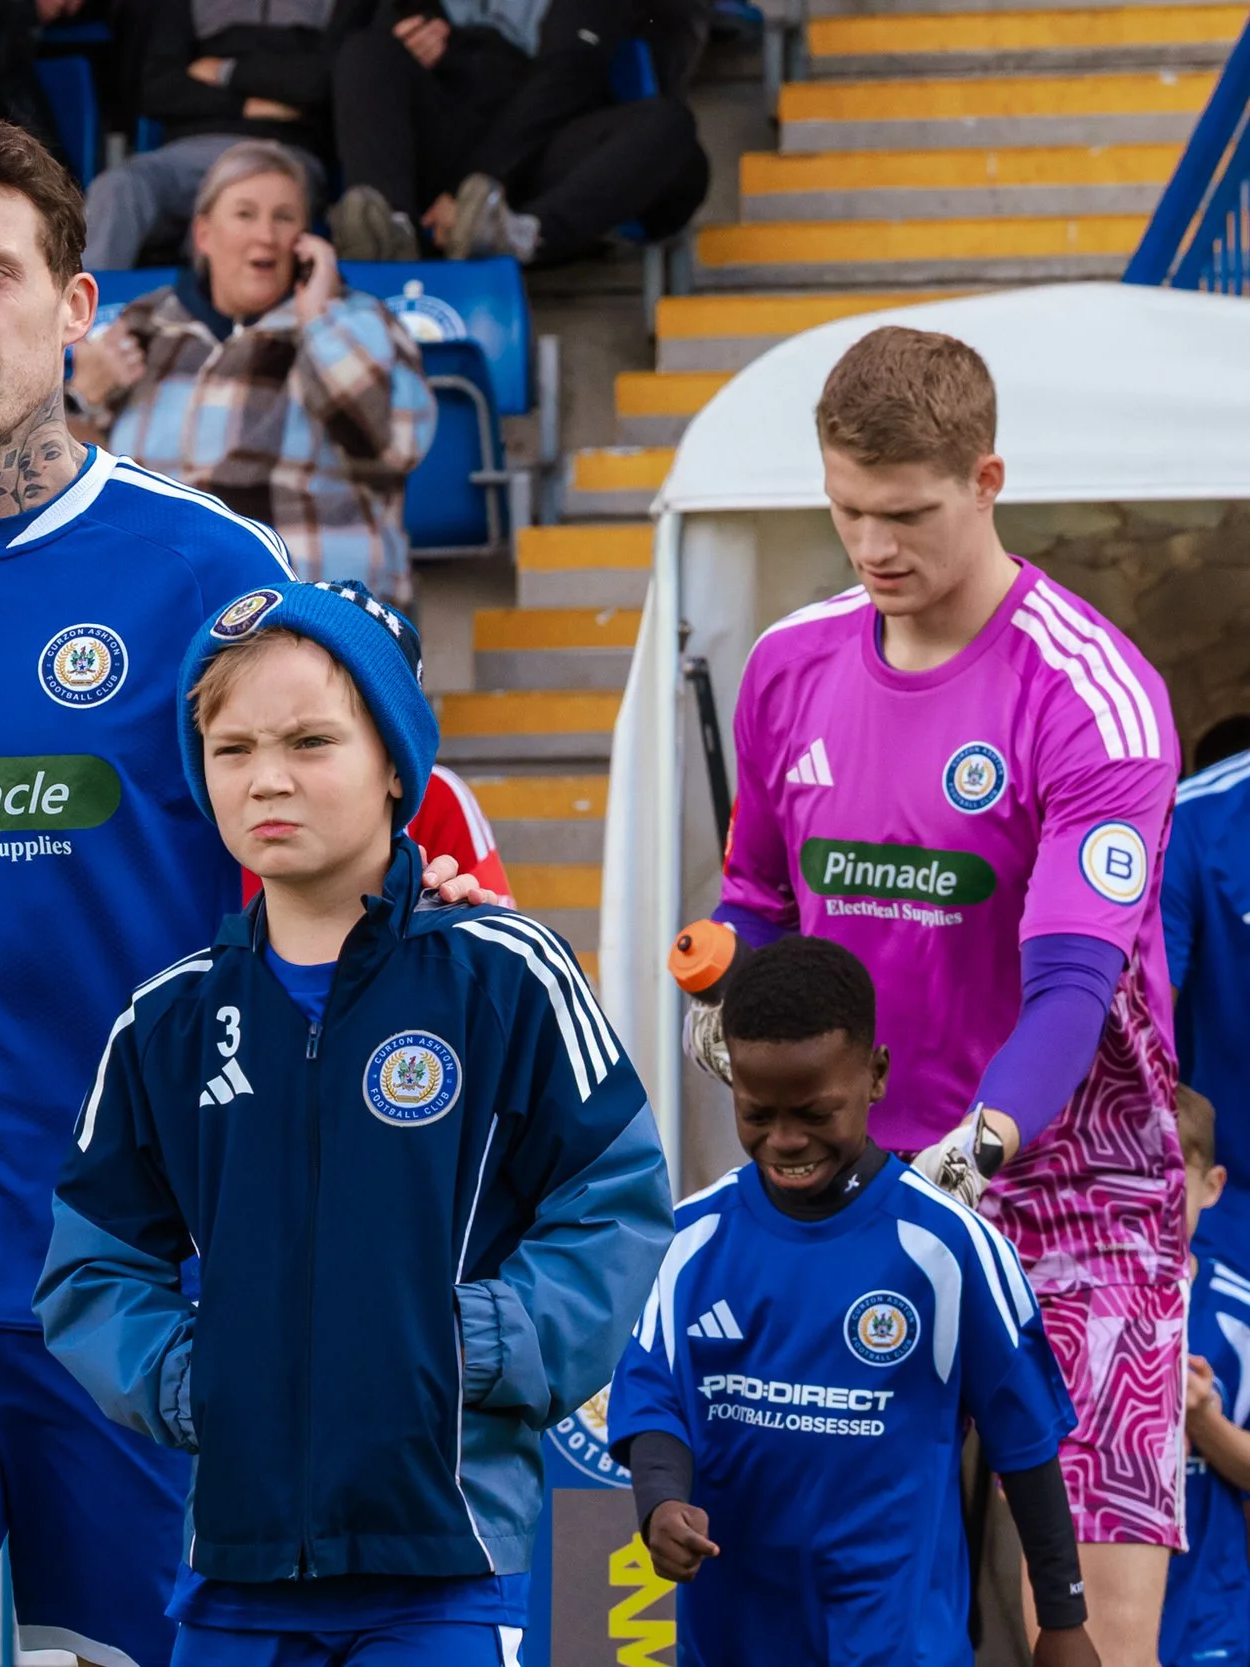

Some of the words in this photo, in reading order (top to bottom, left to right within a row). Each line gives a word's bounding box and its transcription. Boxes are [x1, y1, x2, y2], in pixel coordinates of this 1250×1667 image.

[47, 629, 84, 657] CURZON
[88, 628, 121, 656] ASHTON
[46, 675, 93, 701] FOOTBALL
[96, 675, 118, 697] CLUB
[823, 851, 958, 896] Pinnacle
[1106, 846, 1133, 880] B
[825, 899, 899, 919] Electrical
[902, 902, 963, 928] Supplies
[216, 1005, 241, 1058] 3
[374, 1037, 413, 1064] CURZON
[418, 1038, 454, 1071] ASHTON
[370, 1088, 419, 1118] FOOTBALL
[424, 1091, 450, 1115] CLUB
